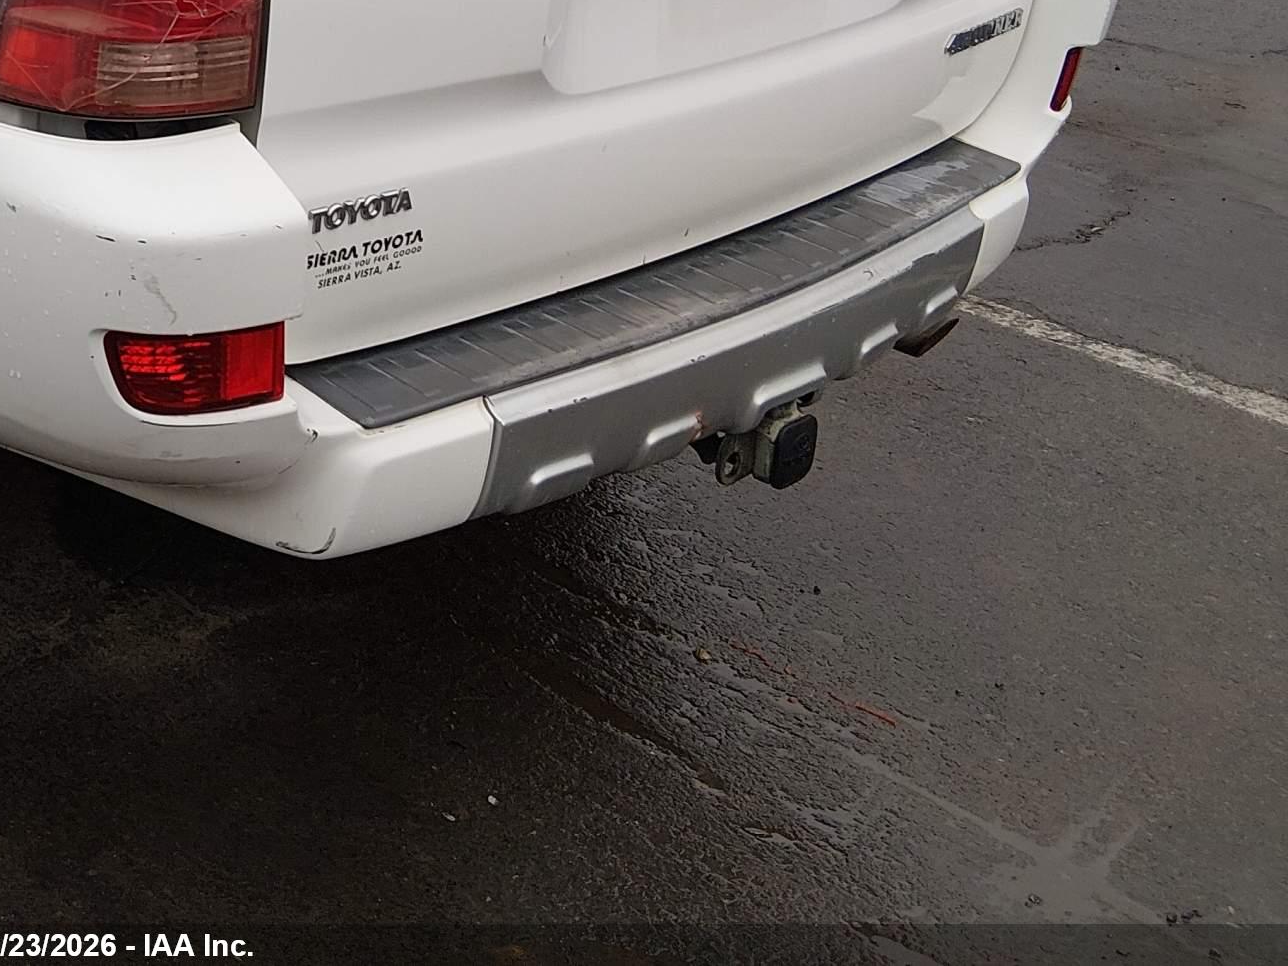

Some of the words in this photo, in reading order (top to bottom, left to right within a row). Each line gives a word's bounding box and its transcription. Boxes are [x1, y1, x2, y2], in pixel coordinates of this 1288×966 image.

[308, 187, 412, 234] TOYOTA
[307, 245, 358, 270] SIERRA
[362, 229, 423, 257] TOYOTA
[355, 258, 371, 268] YOU
[373, 254, 389, 264] FEEL
[317, 273, 351, 289] SIERRA
[354, 265, 382, 279] VISTA,
